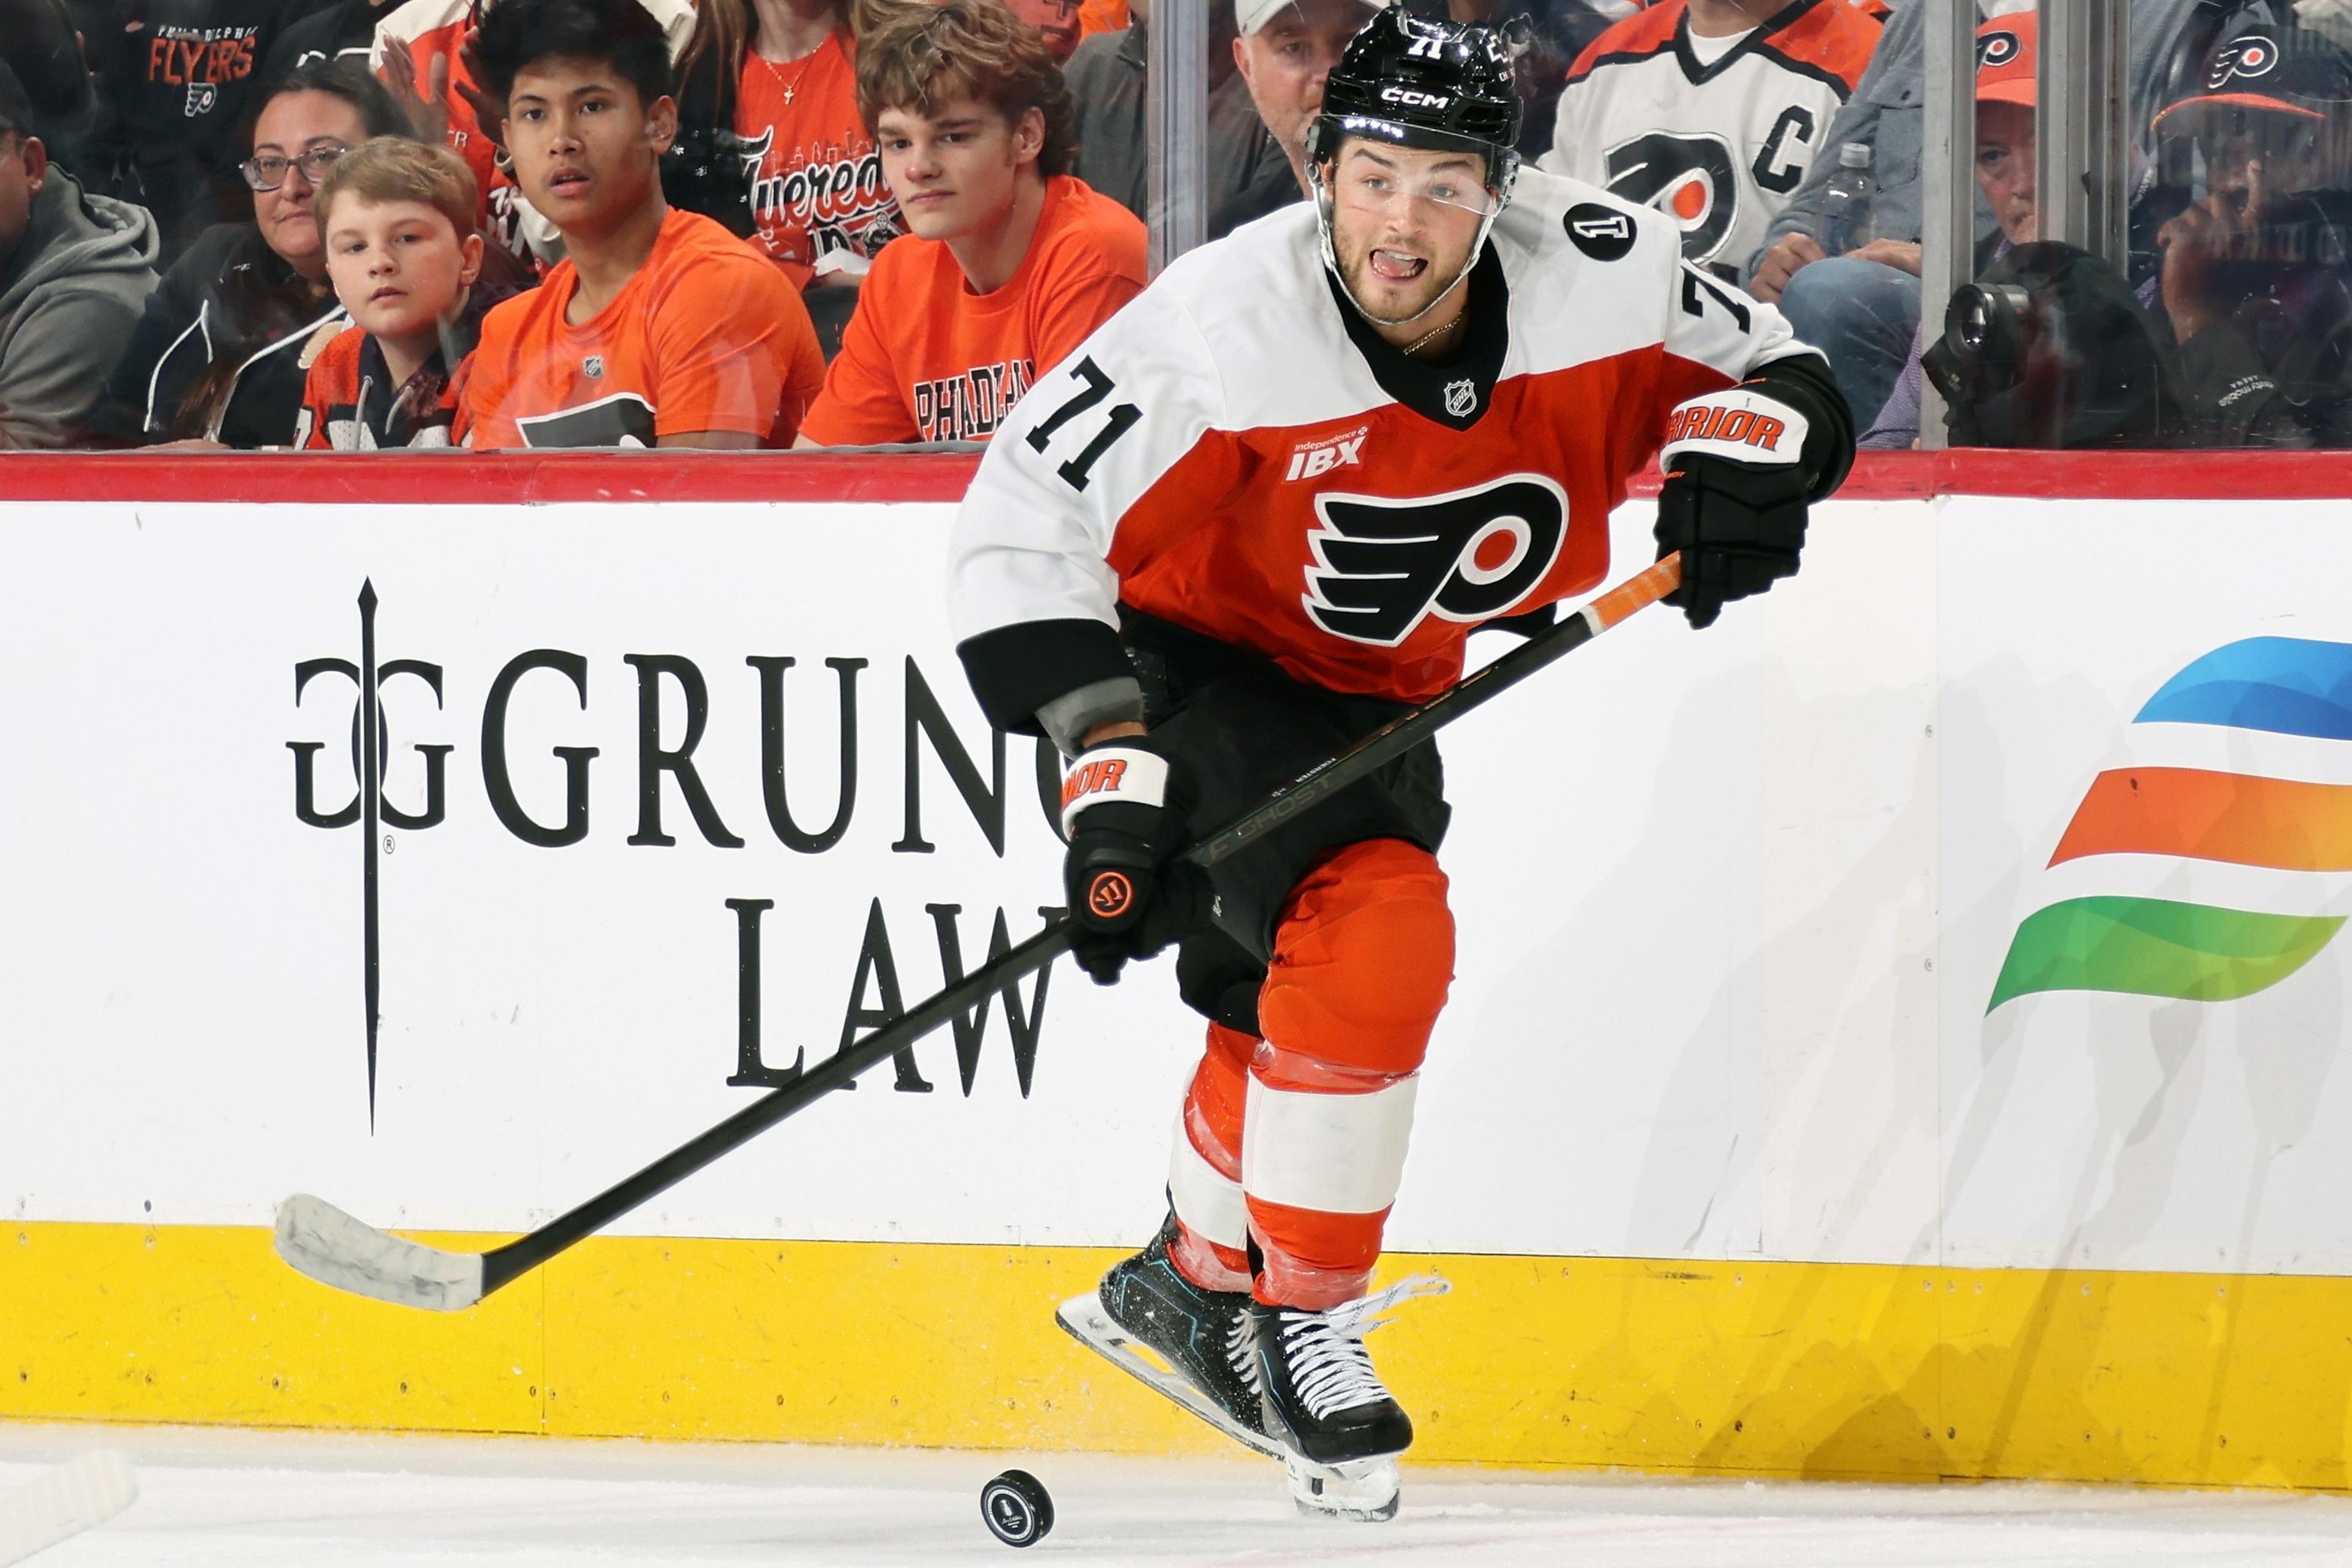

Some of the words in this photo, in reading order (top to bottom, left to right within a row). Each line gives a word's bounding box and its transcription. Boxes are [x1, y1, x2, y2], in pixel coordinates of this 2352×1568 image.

[148, 36, 257, 85] FLYERS
[1380, 87, 1450, 109] CCM
[1752, 105, 1815, 194] C
[1025, 353, 1144, 493] 71
[1452, 388, 1469, 410] NHL
[1285, 435, 1366, 481] IBX
[1294, 429, 1357, 452] Independence
[1236, 771, 1333, 840] GHOST
[725, 895, 1069, 1100] LAW
